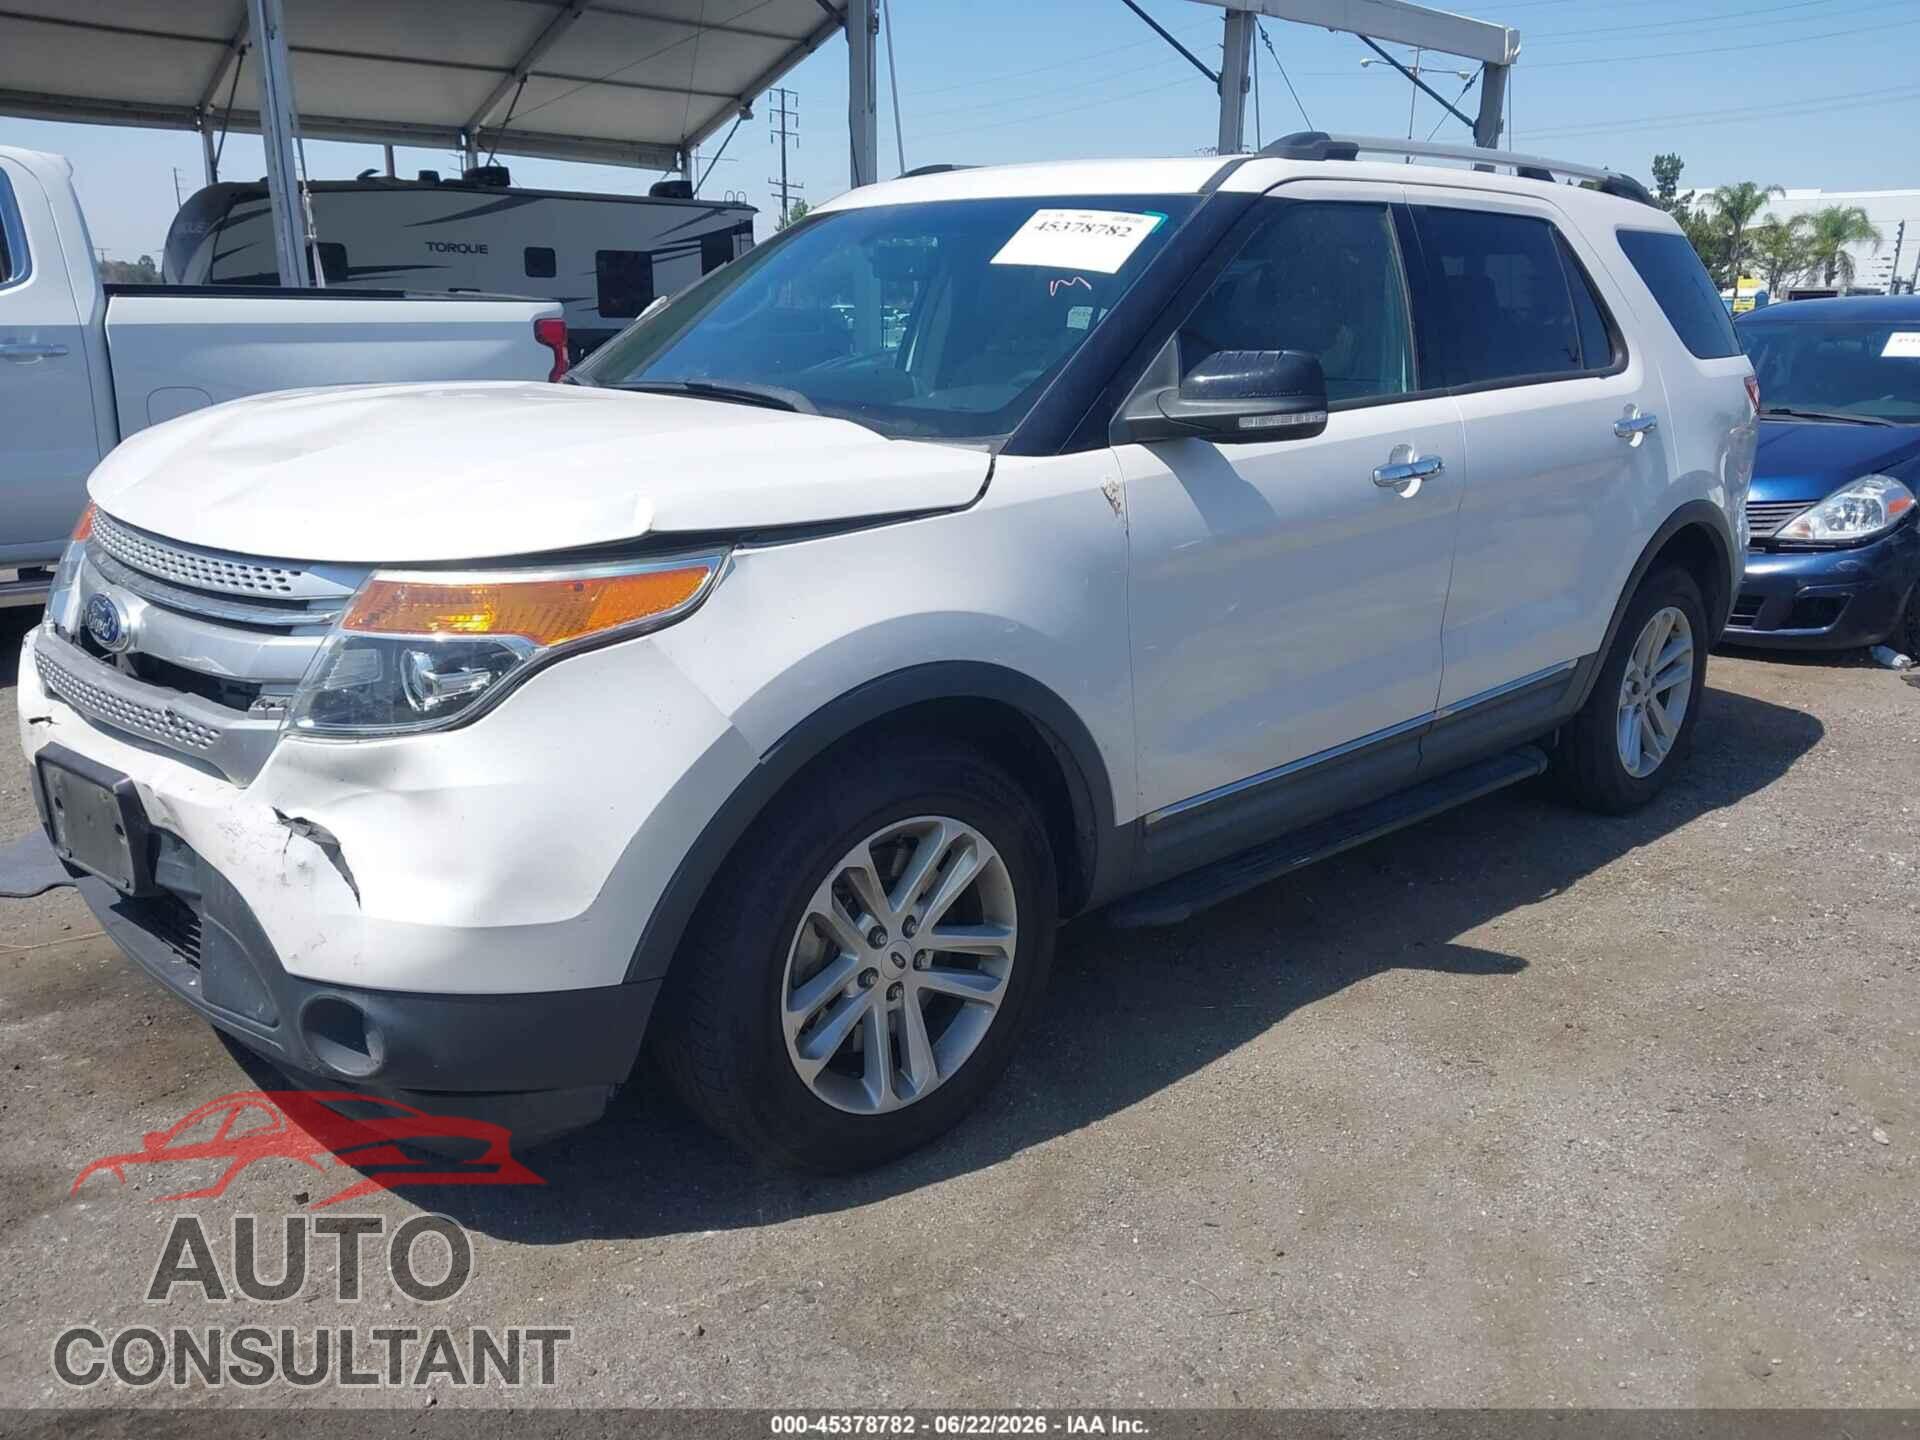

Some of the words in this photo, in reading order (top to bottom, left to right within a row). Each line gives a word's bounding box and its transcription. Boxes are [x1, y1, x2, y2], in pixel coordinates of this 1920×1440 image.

[1034, 220, 1133, 238] 45378782
[424, 241, 489, 255] TORQUE
[90, 599, 114, 640] Ford
